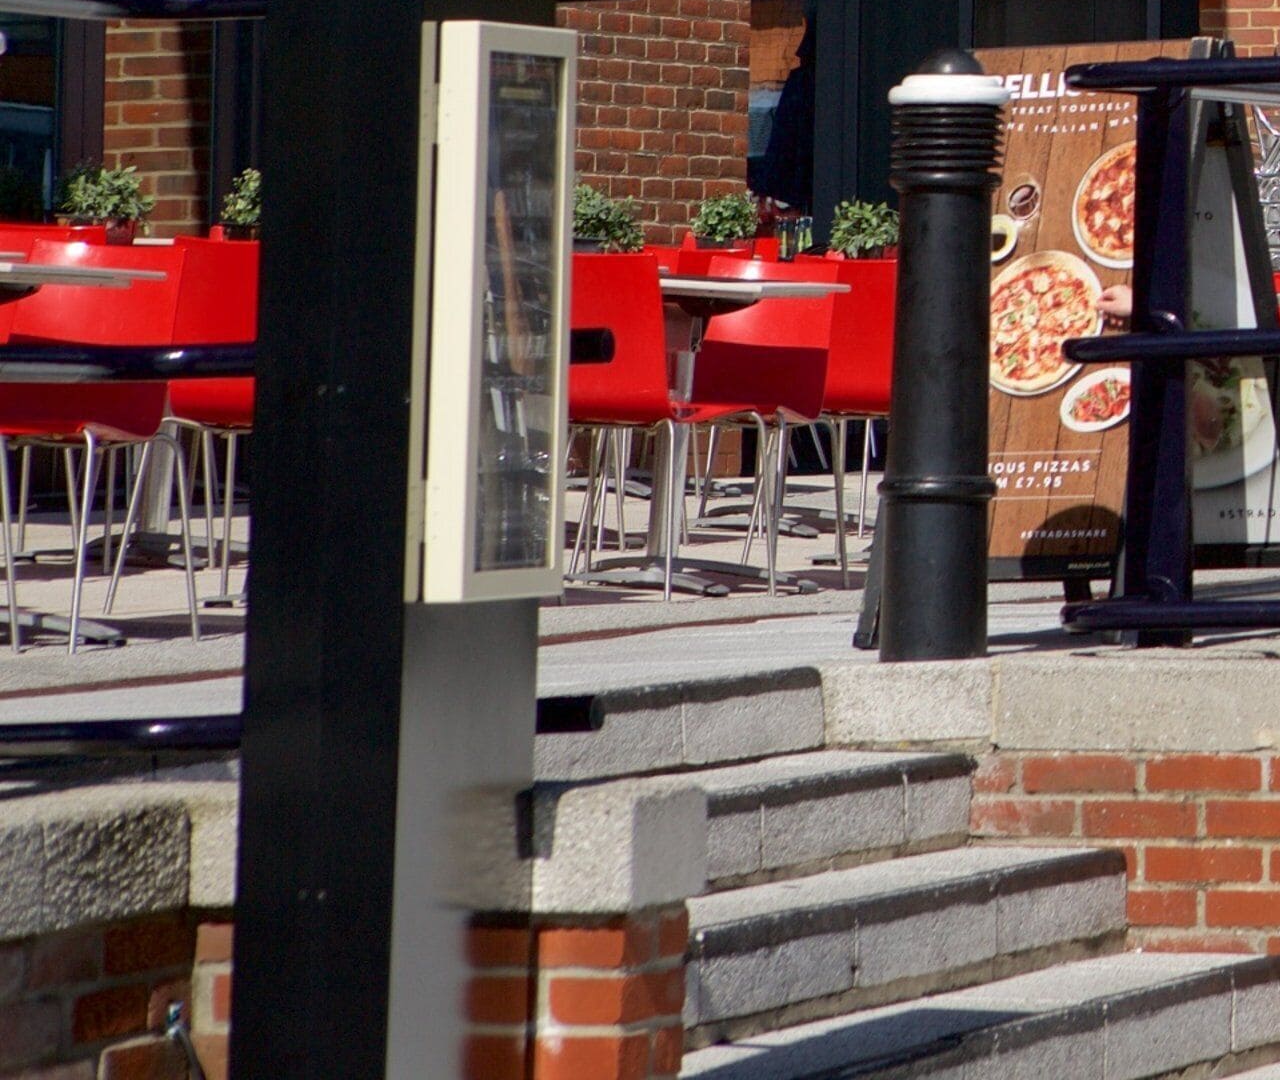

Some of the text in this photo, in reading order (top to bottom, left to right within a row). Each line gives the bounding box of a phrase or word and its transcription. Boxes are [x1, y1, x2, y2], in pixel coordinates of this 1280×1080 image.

[1011, 101, 1131, 115] TREAT YOURSELF
[998, 122, 1024, 132] HE
[1034, 122, 1099, 133] ITALIAN
[1033, 460, 1091, 472] PIZZAS
[1015, 476, 1063, 489] £7.95
[1020, 528, 1107, 540] #STRADASHARE
